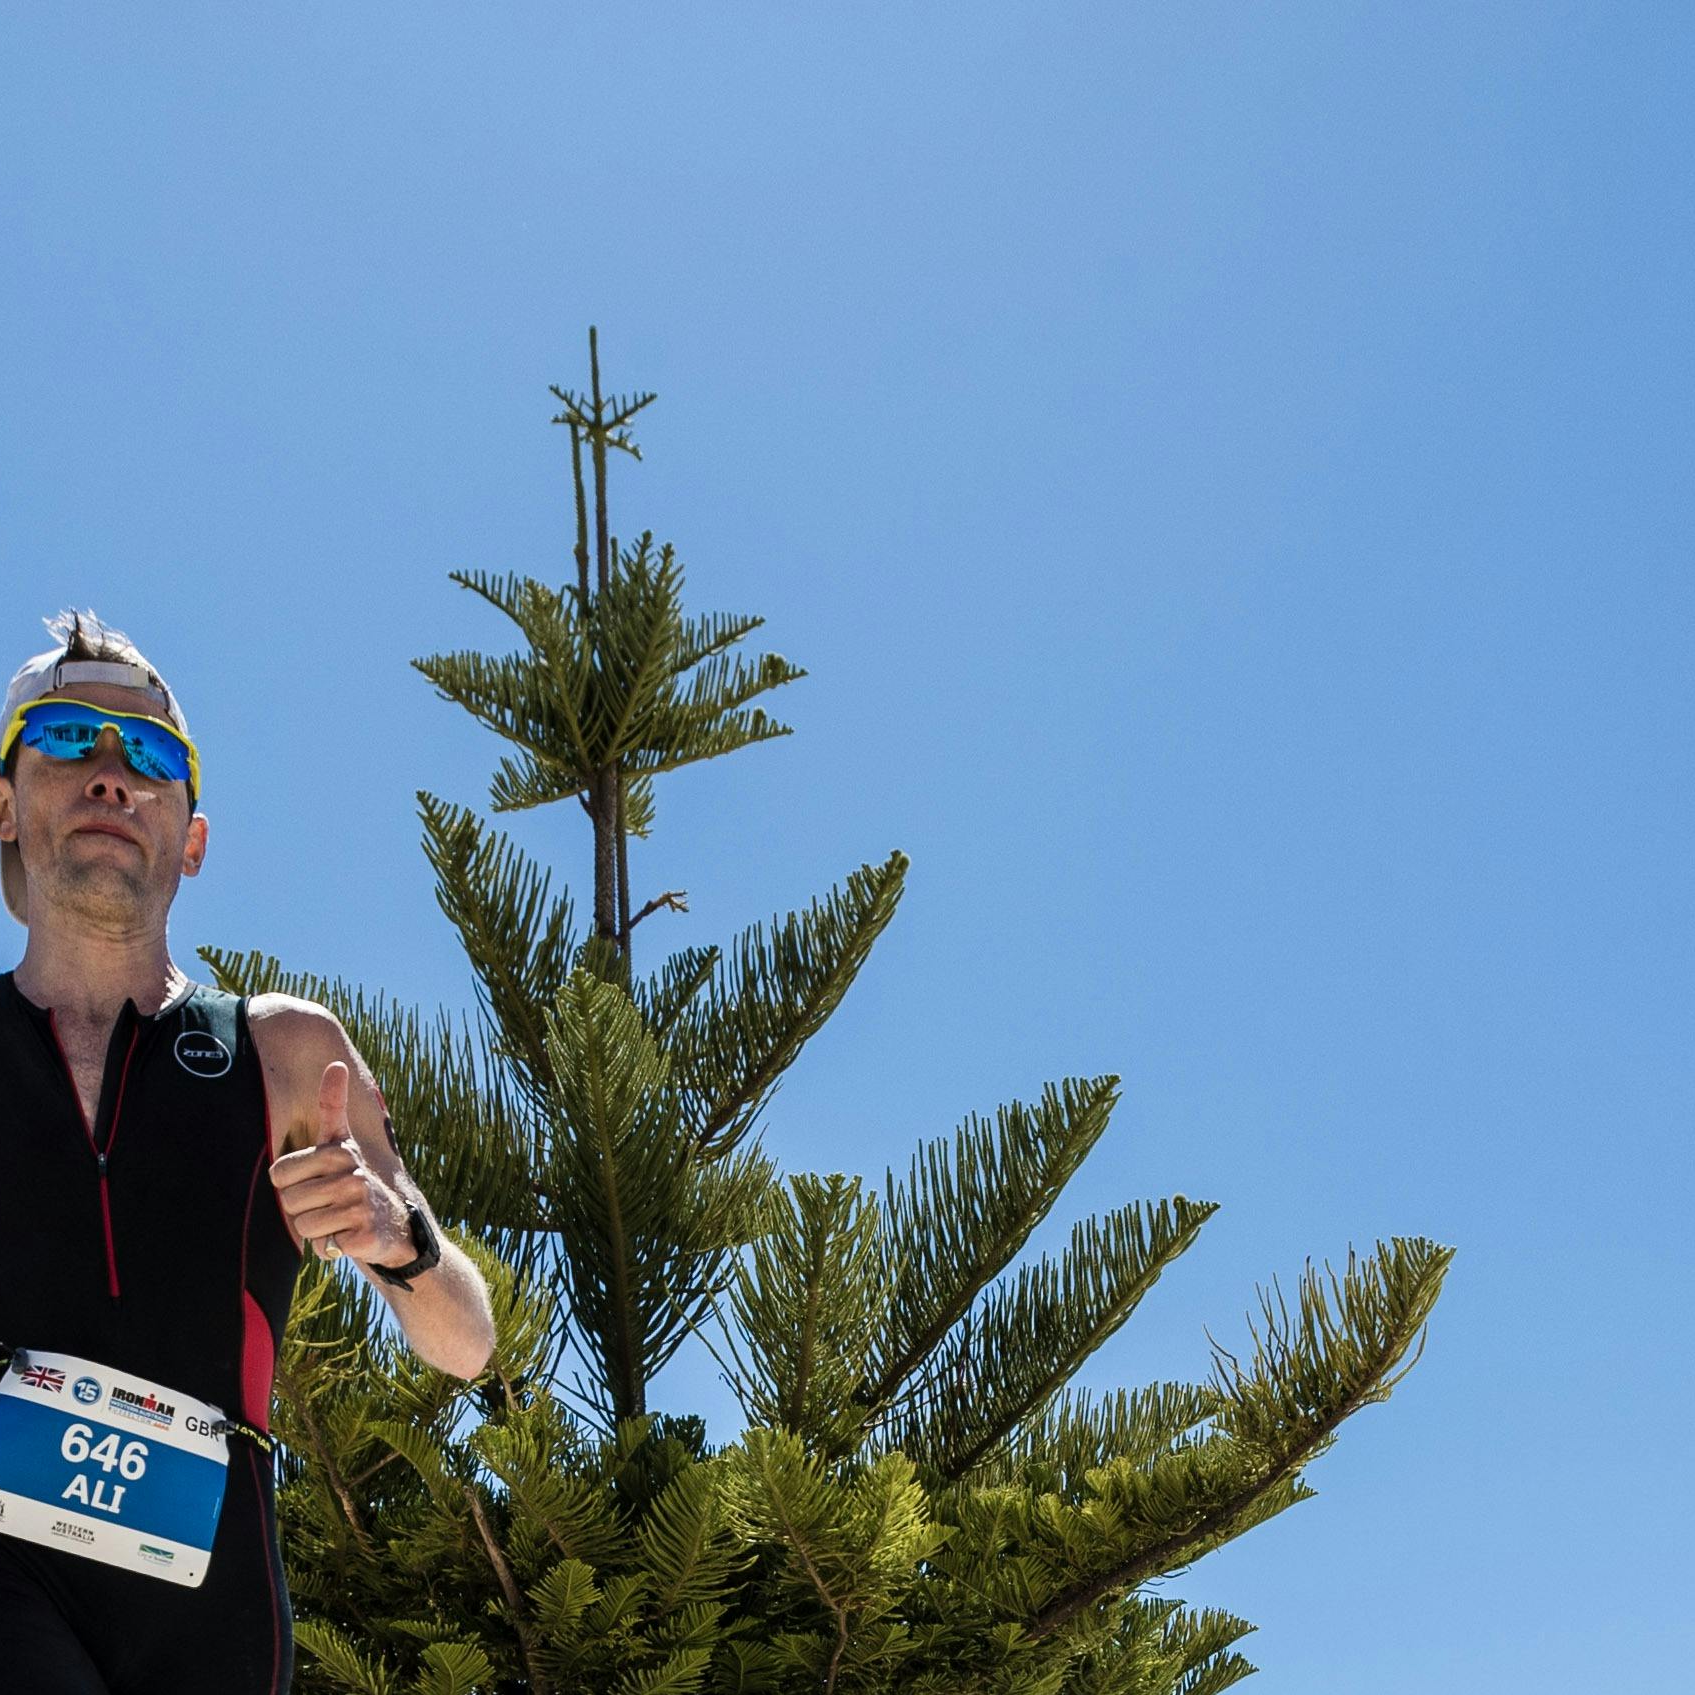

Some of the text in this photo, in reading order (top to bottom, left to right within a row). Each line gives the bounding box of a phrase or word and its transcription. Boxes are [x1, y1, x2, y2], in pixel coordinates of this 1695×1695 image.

[111, 1387, 175, 1417] IRONMAN
[185, 1416, 219, 1442] GBR
[60, 1423, 149, 1481] 646
[61, 1474, 127, 1514] ALI
[51, 1526, 95, 1541] AUSTRALIA
[56, 1521, 94, 1535] WESTERN
